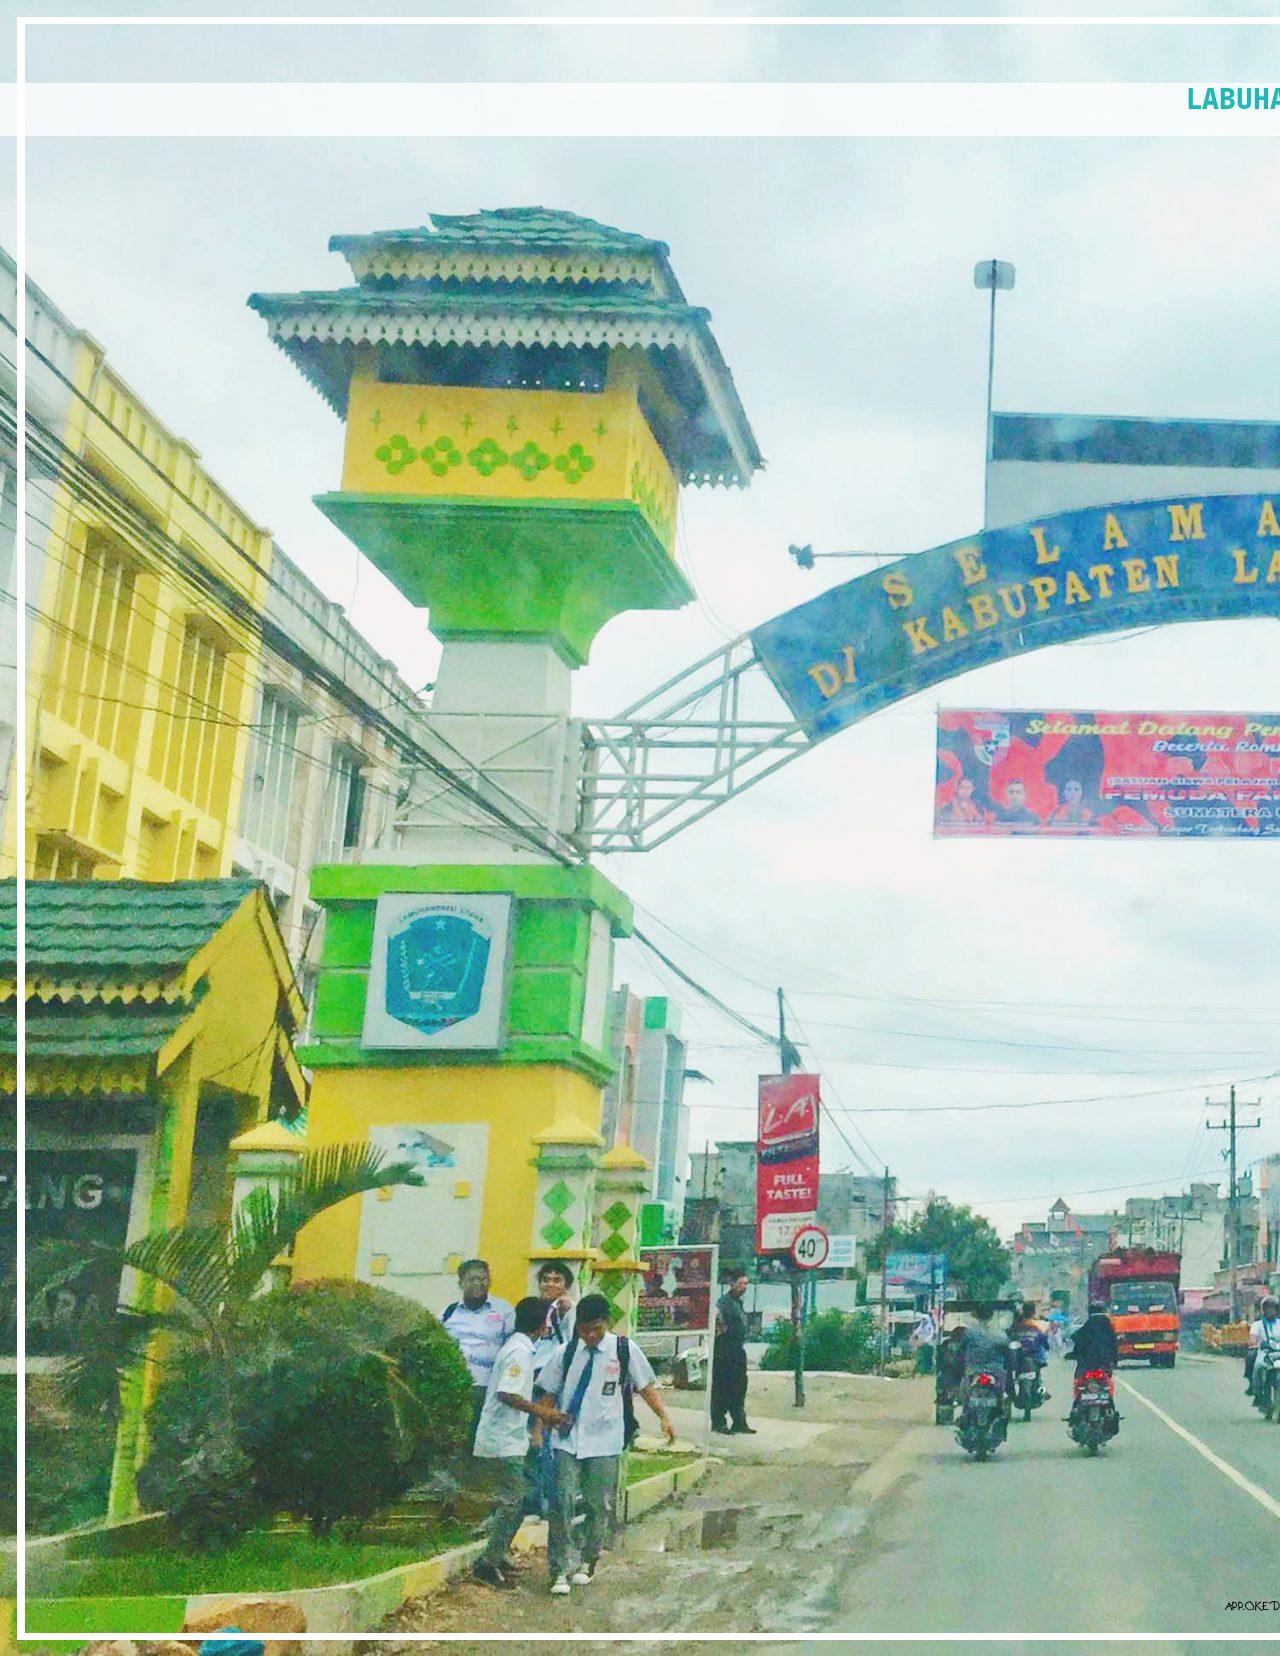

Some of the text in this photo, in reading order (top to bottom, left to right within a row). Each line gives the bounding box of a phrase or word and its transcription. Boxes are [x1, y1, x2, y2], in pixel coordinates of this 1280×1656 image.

[807, 646, 857, 699] DI
[902, 554, 1180, 655] KABUPATEN
[1026, 719, 1132, 735] Selamat
[1137, 721, 1234, 739] Datang
[1165, 807, 1272, 818] SUMATERA
[773, 1174, 806, 1186] FULL
[766, 1189, 812, 1201] TASTE!
[798, 1238, 816, 1259] 40
